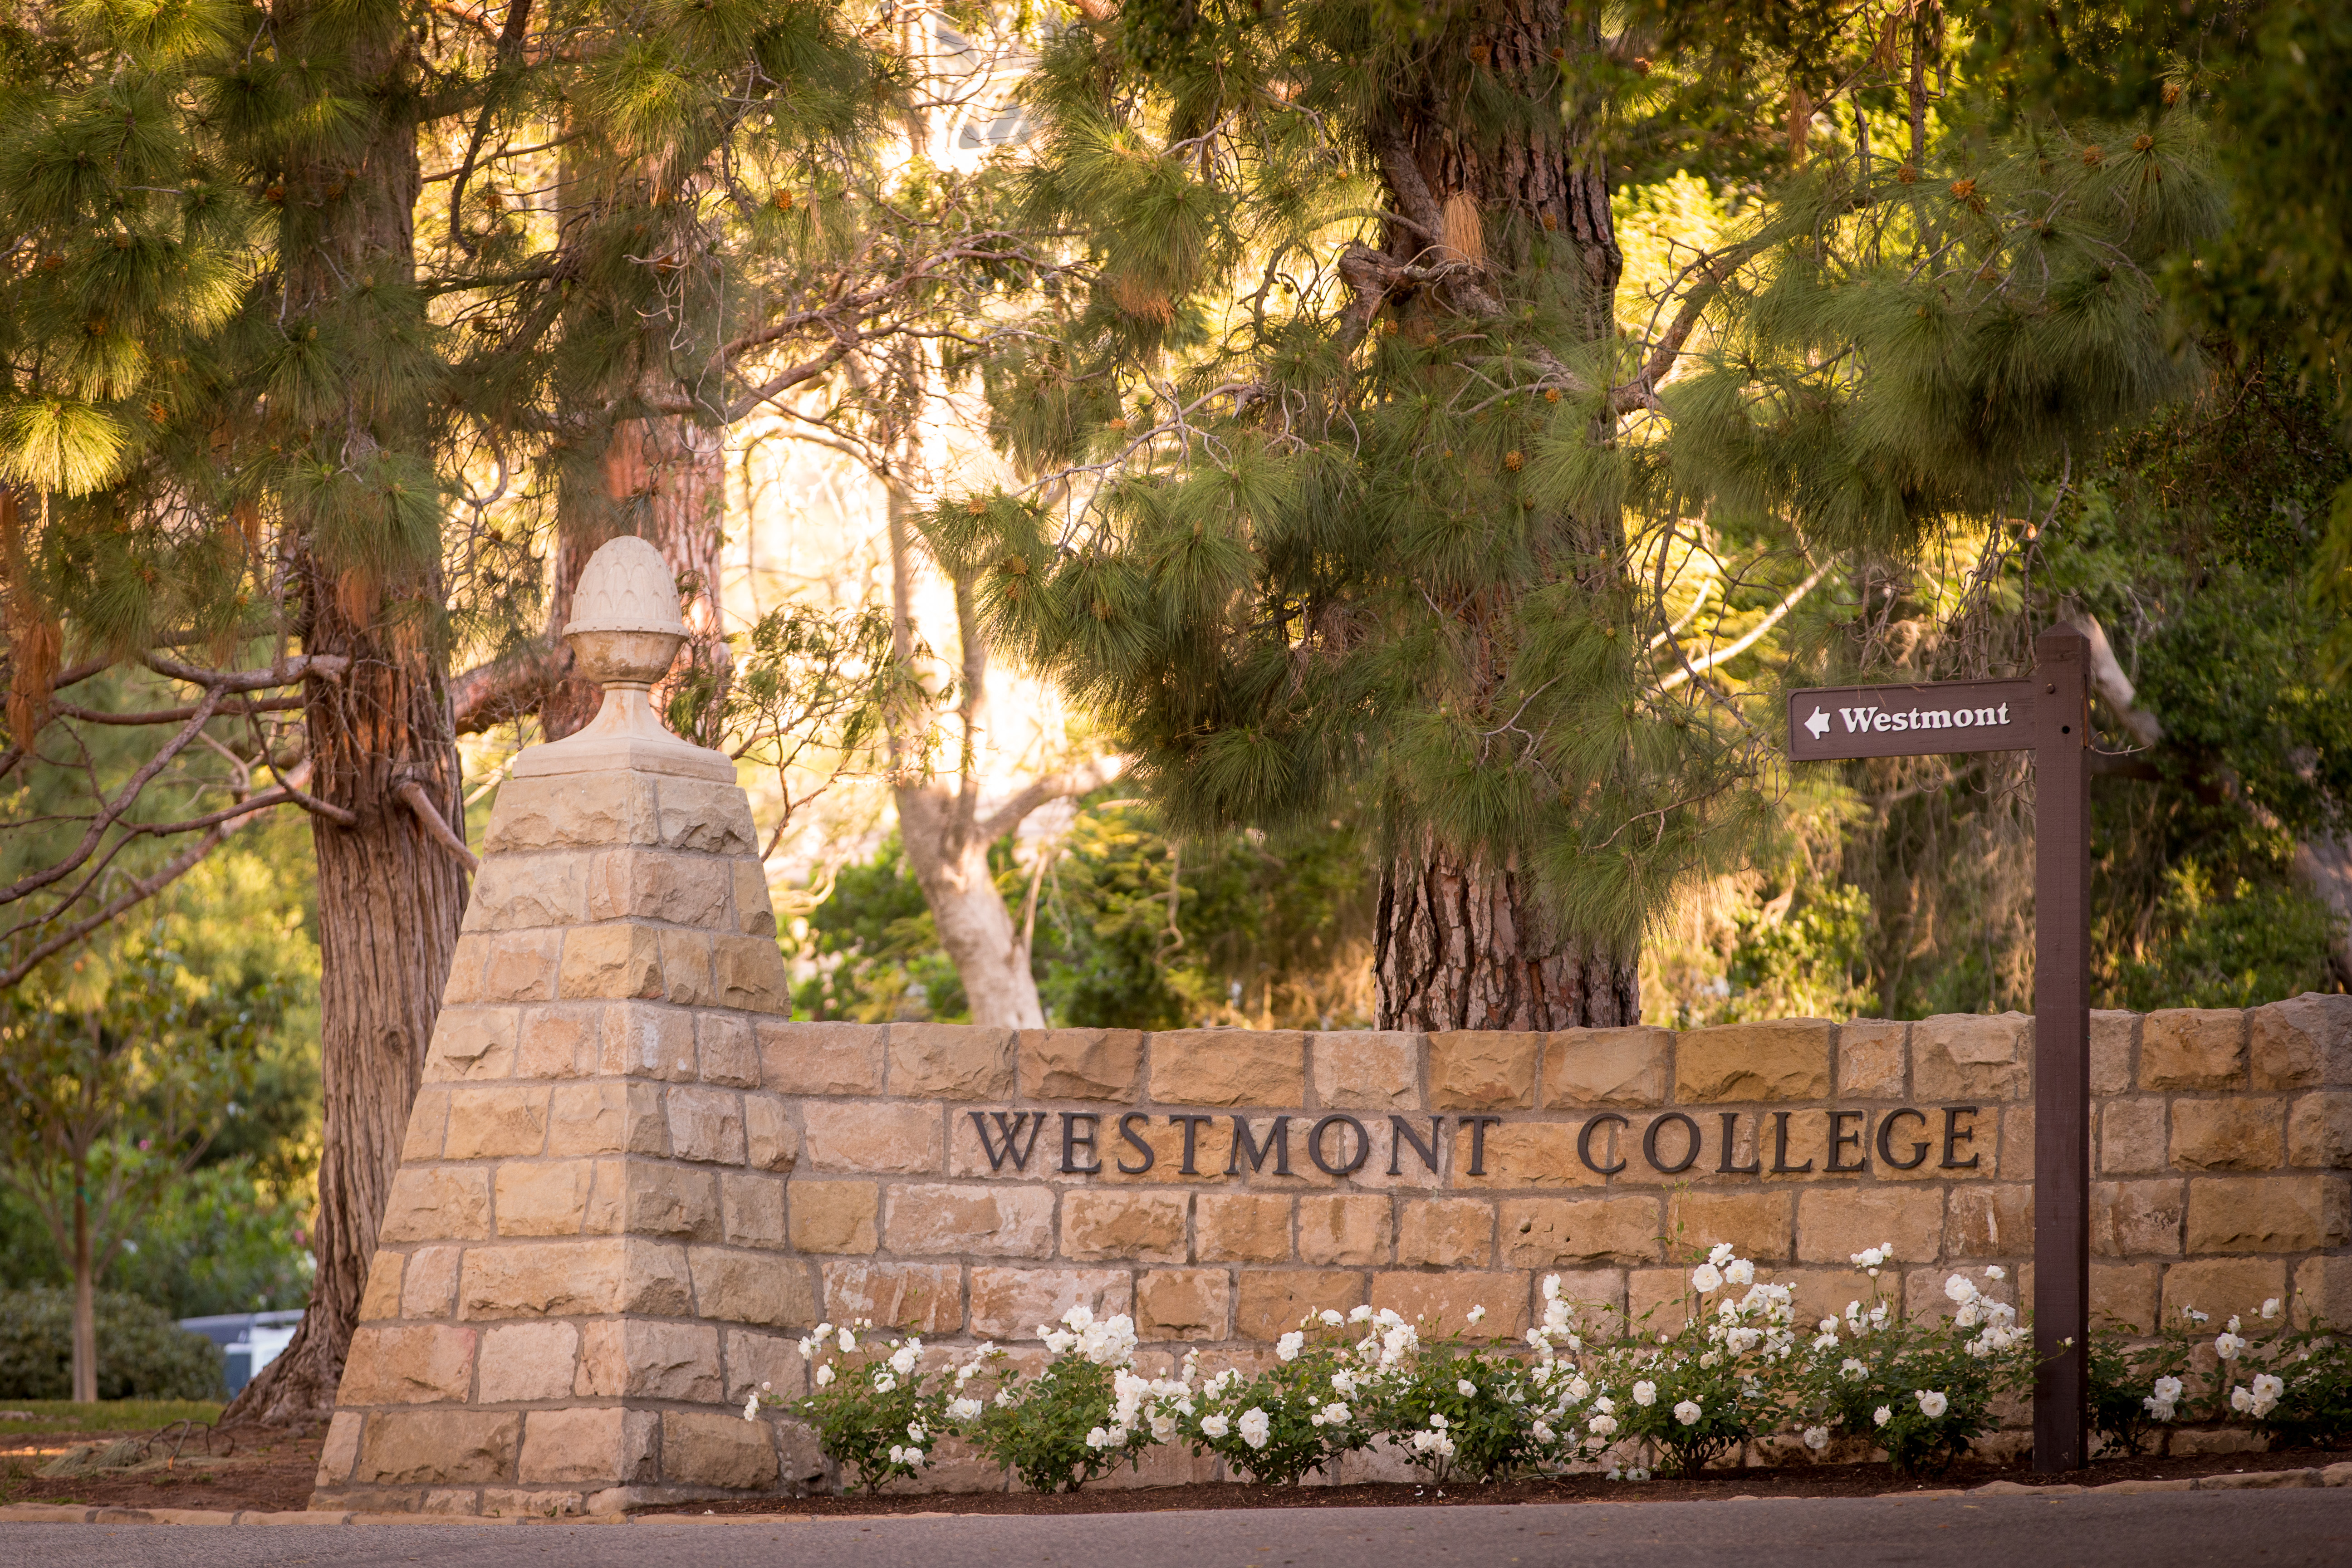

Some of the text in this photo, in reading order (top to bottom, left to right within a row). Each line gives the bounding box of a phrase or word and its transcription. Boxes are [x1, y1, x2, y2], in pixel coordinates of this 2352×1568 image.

[1839, 702, 2010, 733] Westmont
[967, 1105, 1979, 1176] WESTMONT COLLEGE
